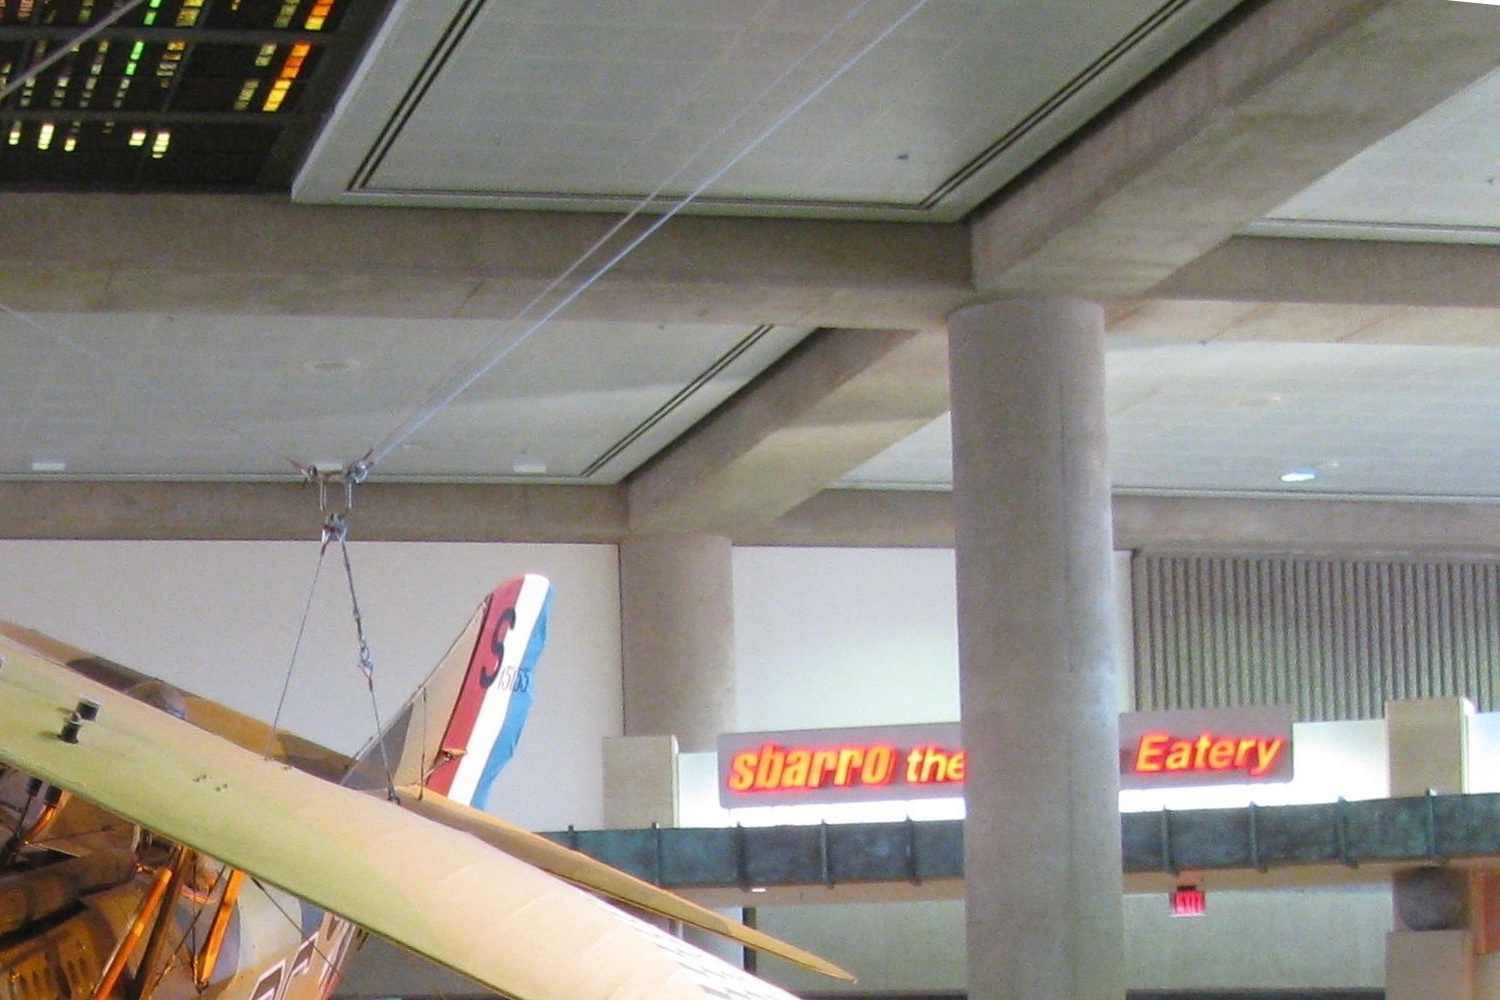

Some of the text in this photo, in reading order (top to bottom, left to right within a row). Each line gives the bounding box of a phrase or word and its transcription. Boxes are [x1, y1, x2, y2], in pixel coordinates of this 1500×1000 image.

[480, 608, 516, 689] S
[728, 733, 1283, 791] sbarro the Eatery
